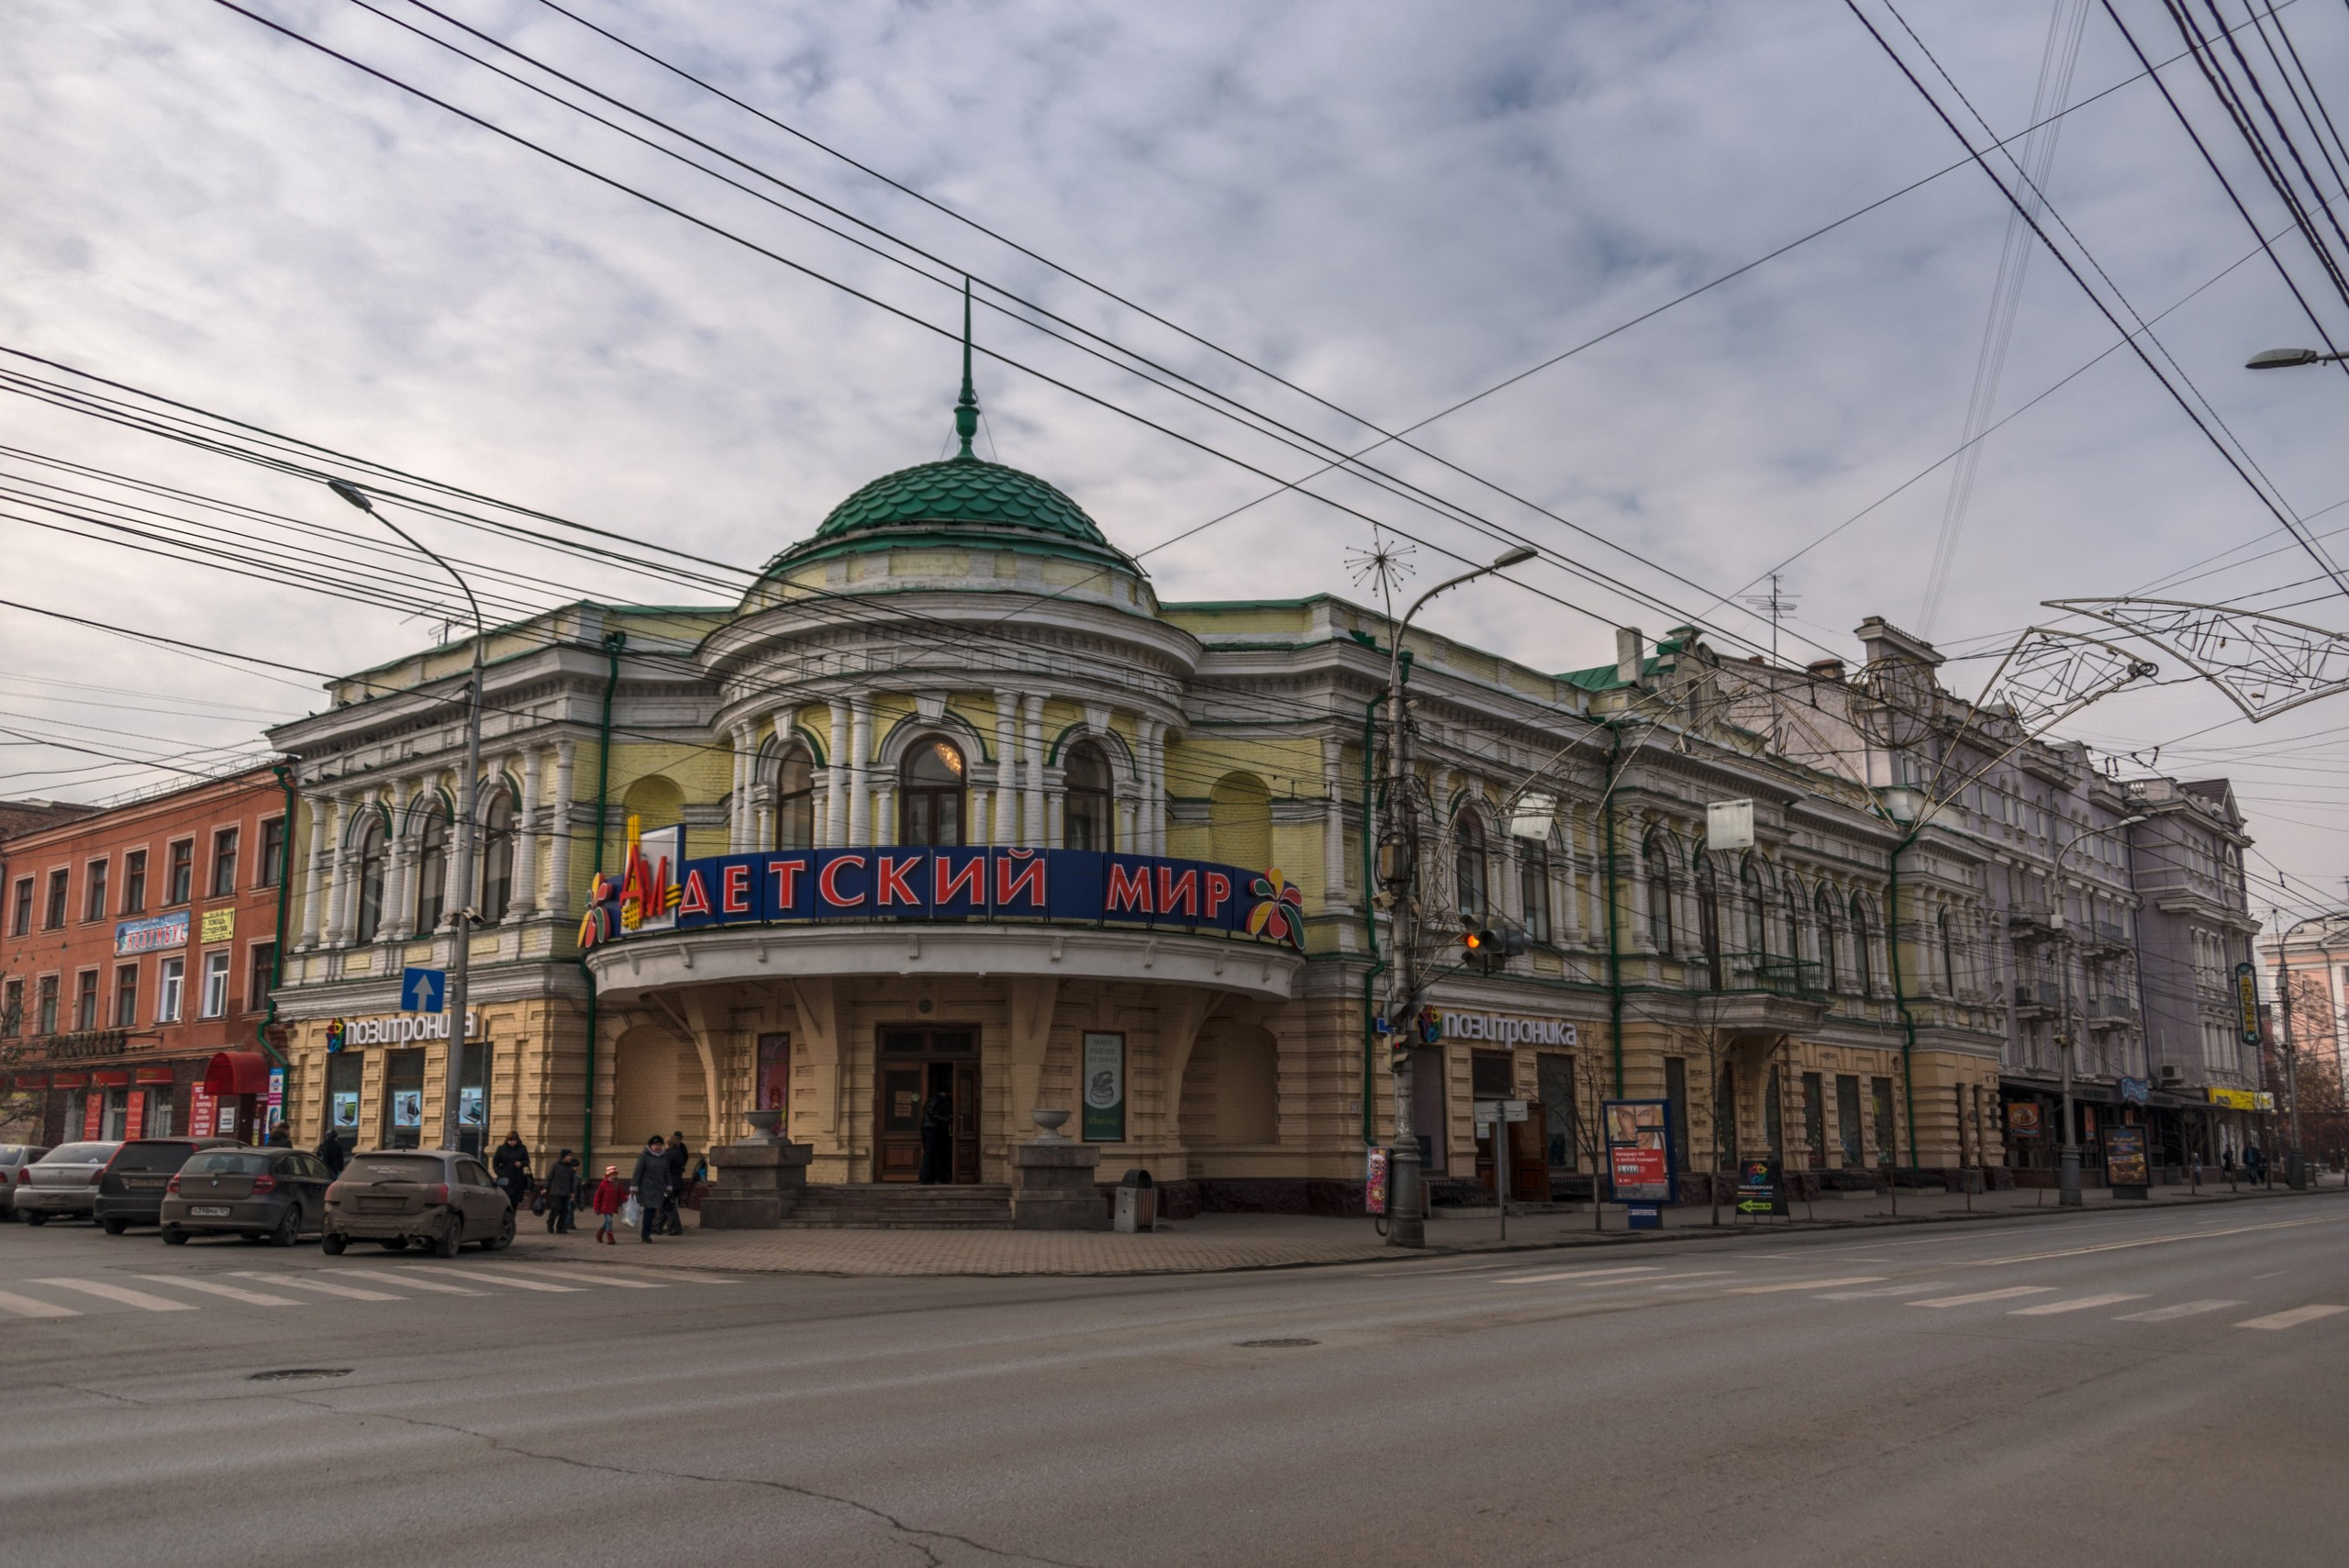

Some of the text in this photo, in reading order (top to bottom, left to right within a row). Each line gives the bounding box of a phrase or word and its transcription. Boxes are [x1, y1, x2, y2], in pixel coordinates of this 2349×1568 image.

[678, 847, 1231, 918] ДЕТСКИЙ МИР
[127, 922, 185, 949] КОЛУМБУС
[2241, 975, 2256, 1032] АПТЕКА
[345, 1011, 478, 1049] позитрониа
[1442, 1012, 1577, 1050] позитроника
